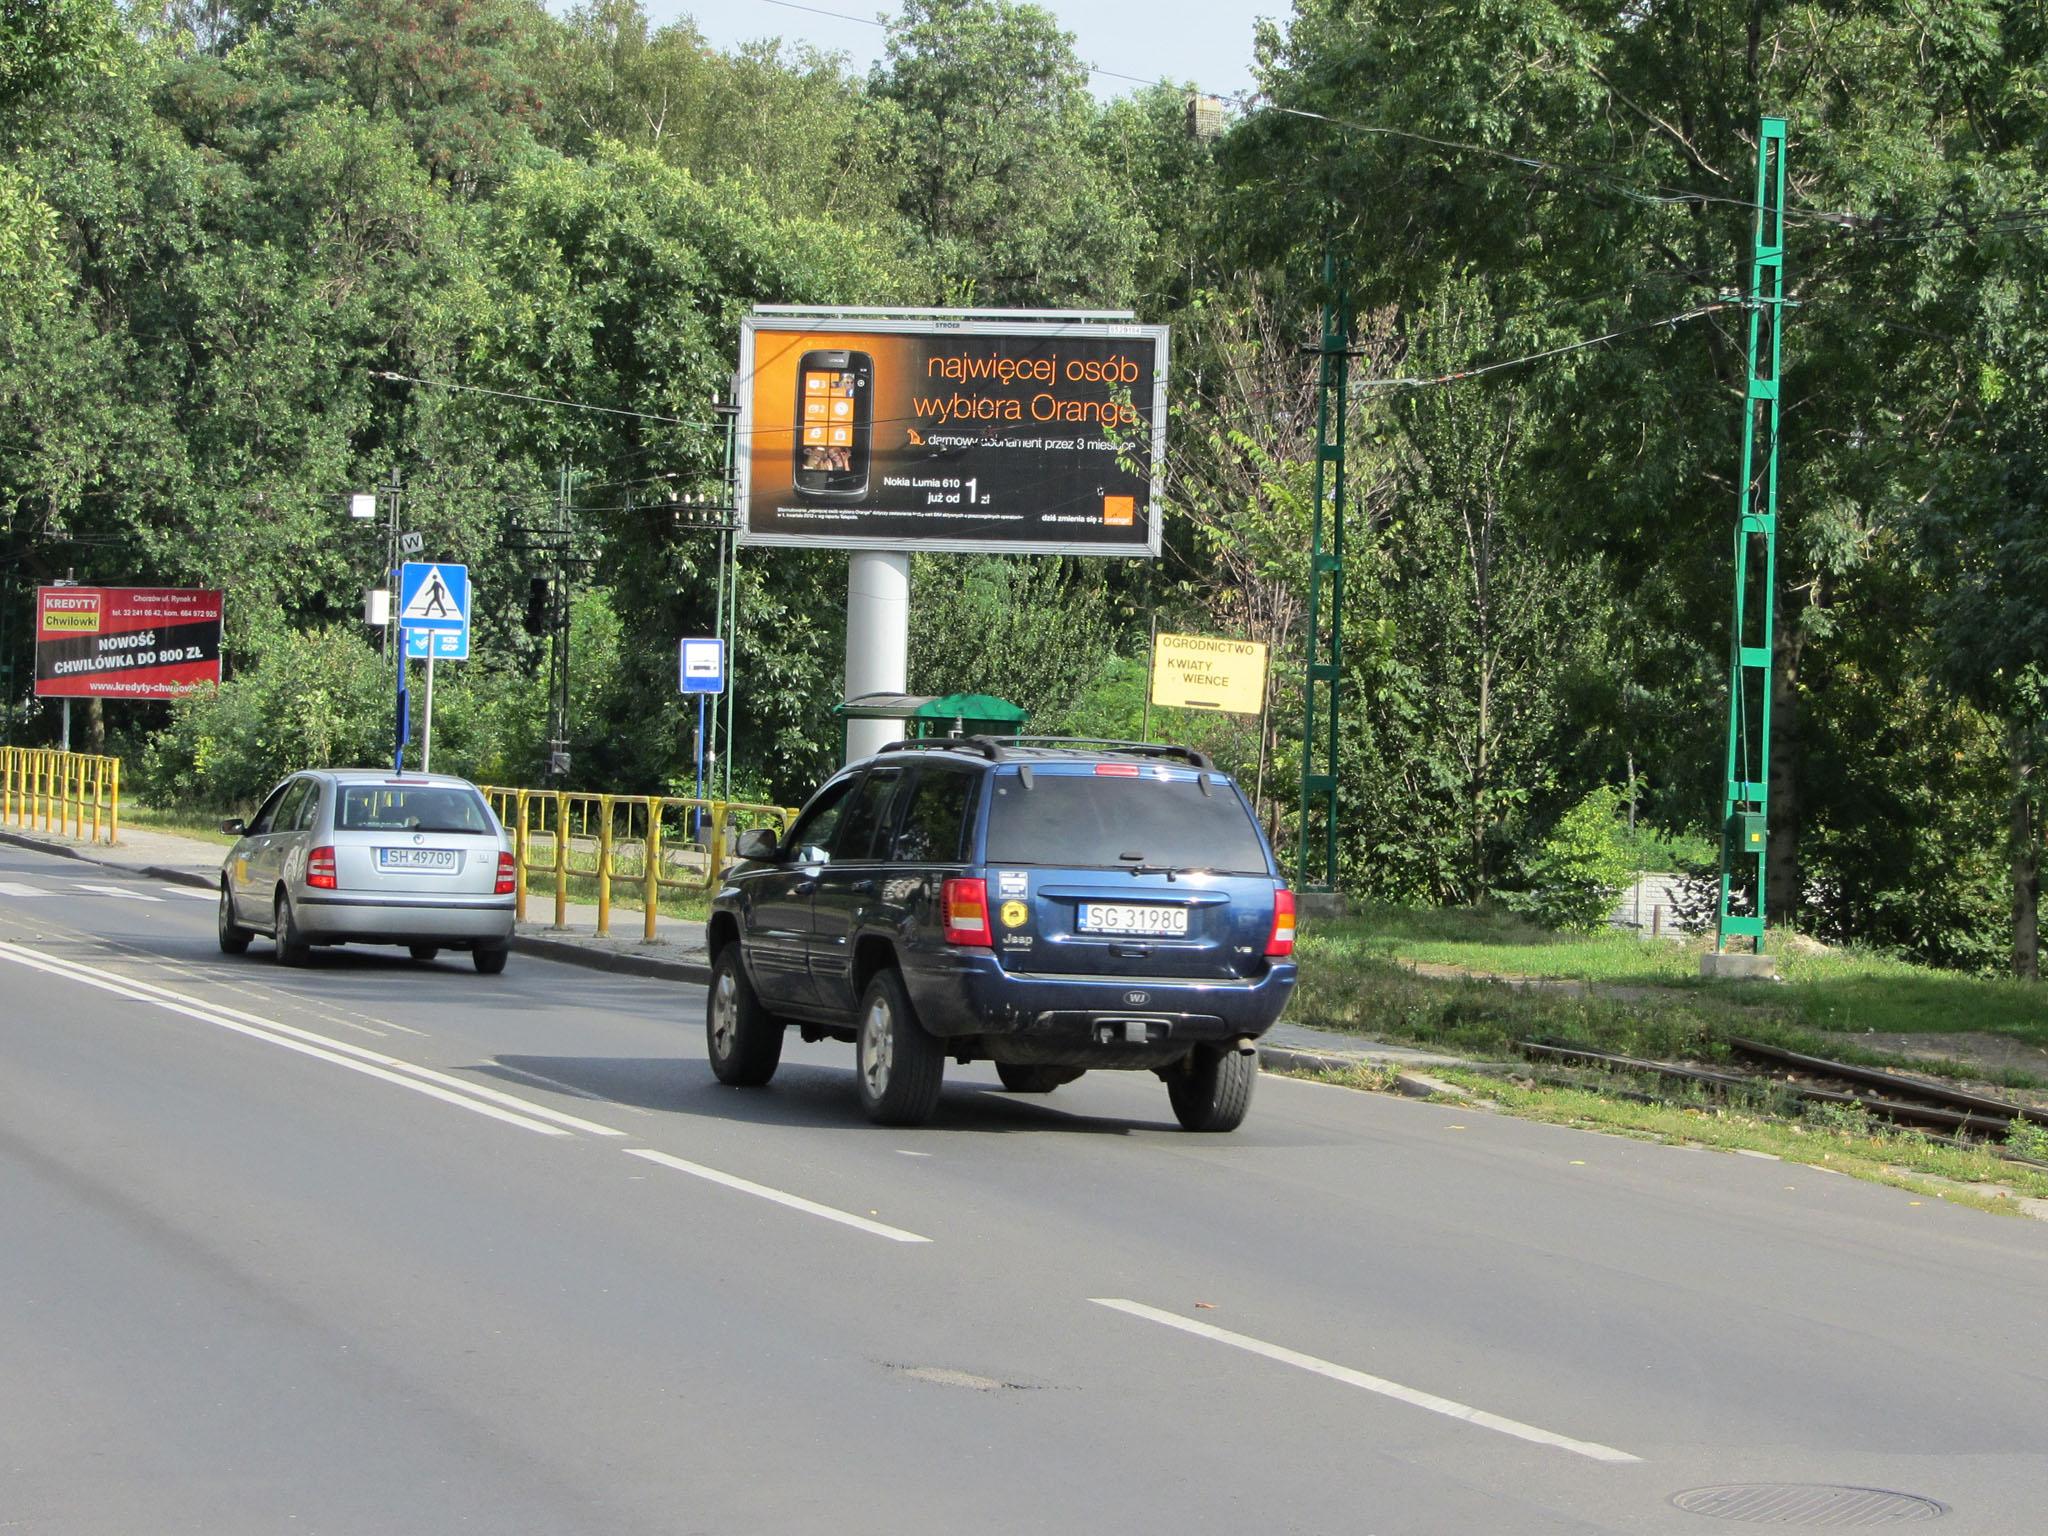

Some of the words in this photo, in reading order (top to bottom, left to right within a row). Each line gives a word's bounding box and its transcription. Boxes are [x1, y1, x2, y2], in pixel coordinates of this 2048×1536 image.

[927, 352, 1057, 386] najwięcej
[1065, 354, 1139, 383] osób
[913, 392, 1022, 424] wybiera
[1030, 393, 1138, 429] Orange
[1044, 438, 1074, 450] przez
[1076, 437, 1085, 450] 3
[883, 477, 910, 487] Nokia
[912, 477, 941, 488] Lumia
[942, 478, 960, 488] 610
[965, 477, 977, 504] 1
[927, 492, 944, 505] już
[945, 493, 960, 504] od
[980, 493, 991, 505] zł
[1057, 514, 1085, 524] zmienia
[404, 535, 421, 550] W
[46, 599, 98, 609] KREDYTY
[46, 616, 98, 627] Chwilówki
[98, 631, 156, 651] NOWOŚĆ
[1163, 637, 1254, 656] OGRODNICTWO
[54, 655, 134, 674] CHWILÓWKA
[137, 652, 156, 664] DO
[159, 649, 183, 663] 800
[186, 646, 203, 659] ZŁ
[1167, 657, 1213, 671] KWIATY
[1183, 672, 1229, 687] WIENCE
[389, 850, 409, 863] SH
[412, 851, 452, 865] 49709
[1090, 907, 1119, 927] SG
[1125, 909, 1184, 930] 3198C
[1002, 933, 1033, 947] Jeep
[1129, 993, 1145, 1003] WJ
